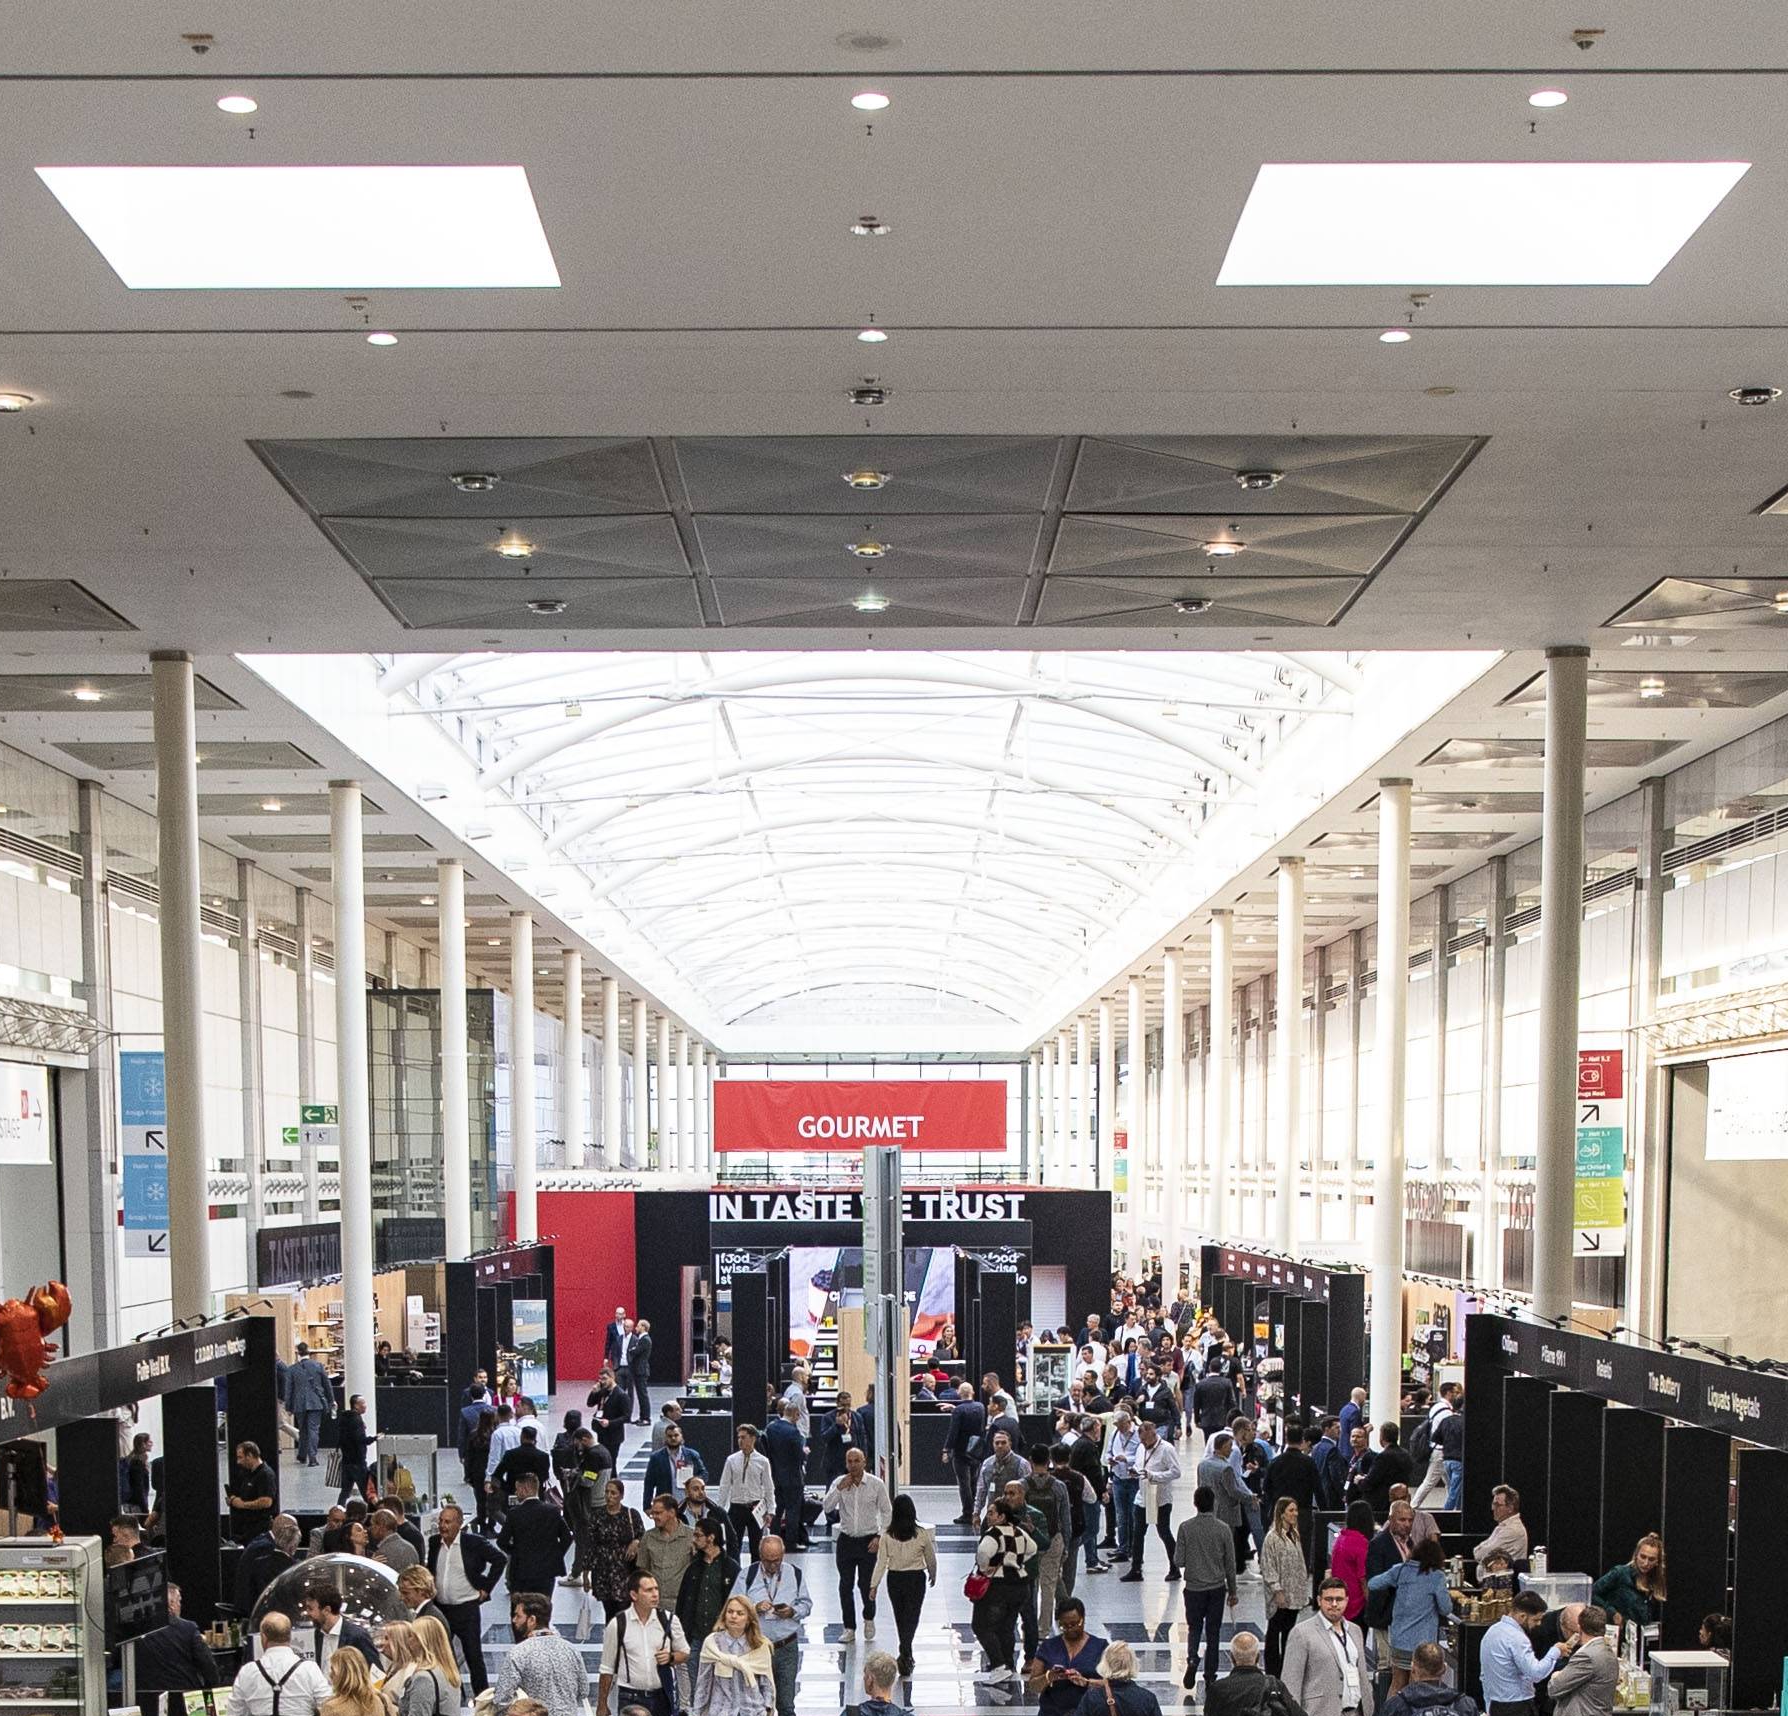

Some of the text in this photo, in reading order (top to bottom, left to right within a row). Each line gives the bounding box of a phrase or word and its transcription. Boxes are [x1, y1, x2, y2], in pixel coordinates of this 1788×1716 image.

[797, 1115, 925, 1140] GOURMET
[709, 1194, 743, 1221] IN
[748, 1194, 853, 1221] TASTE
[919, 1194, 1026, 1221] TRUST
